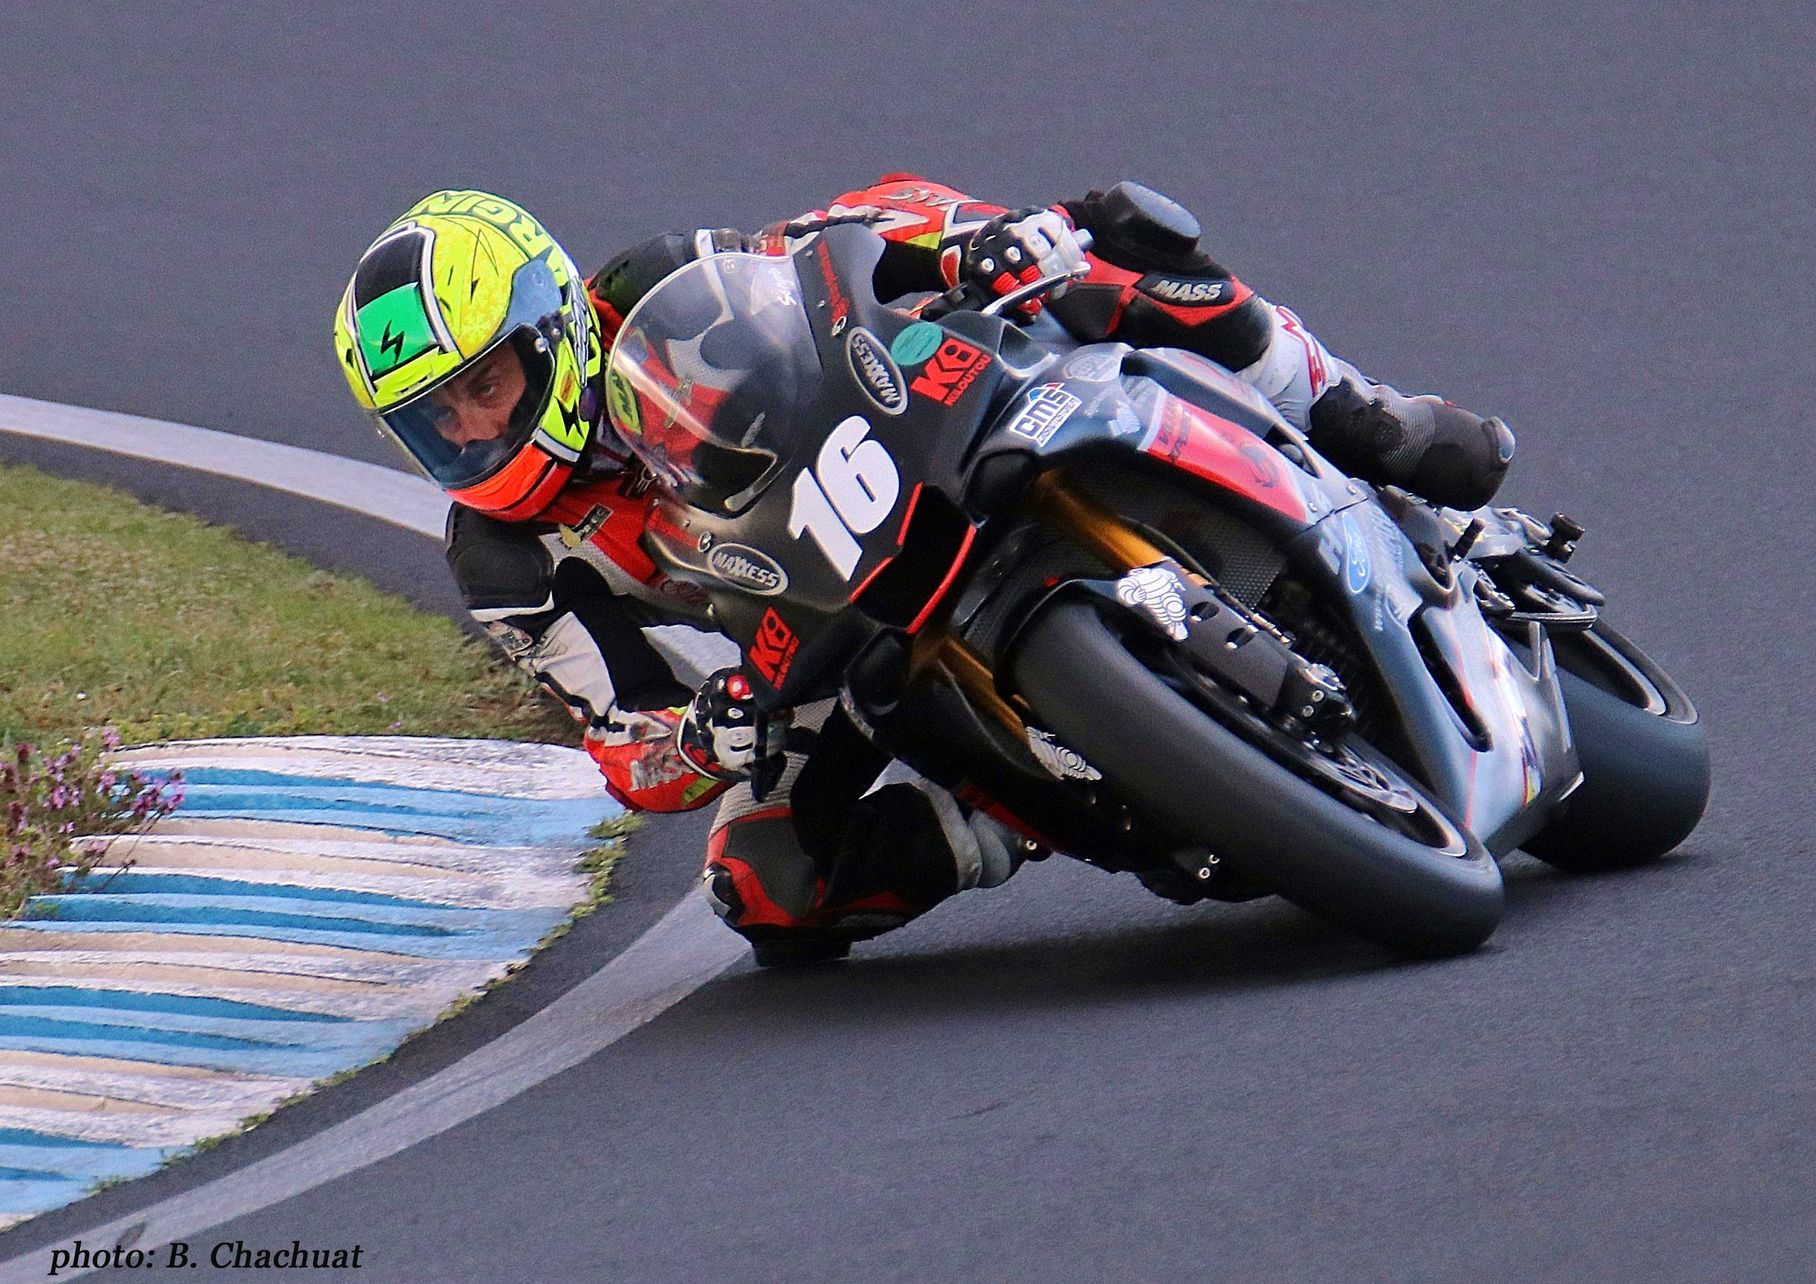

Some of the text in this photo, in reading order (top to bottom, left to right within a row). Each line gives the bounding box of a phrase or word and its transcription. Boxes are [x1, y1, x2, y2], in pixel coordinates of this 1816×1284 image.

[1151, 279, 1223, 301] MASS
[851, 333, 900, 405] MAXXESS
[787, 415, 900, 582] 16
[712, 552, 779, 588] MAXXESS
